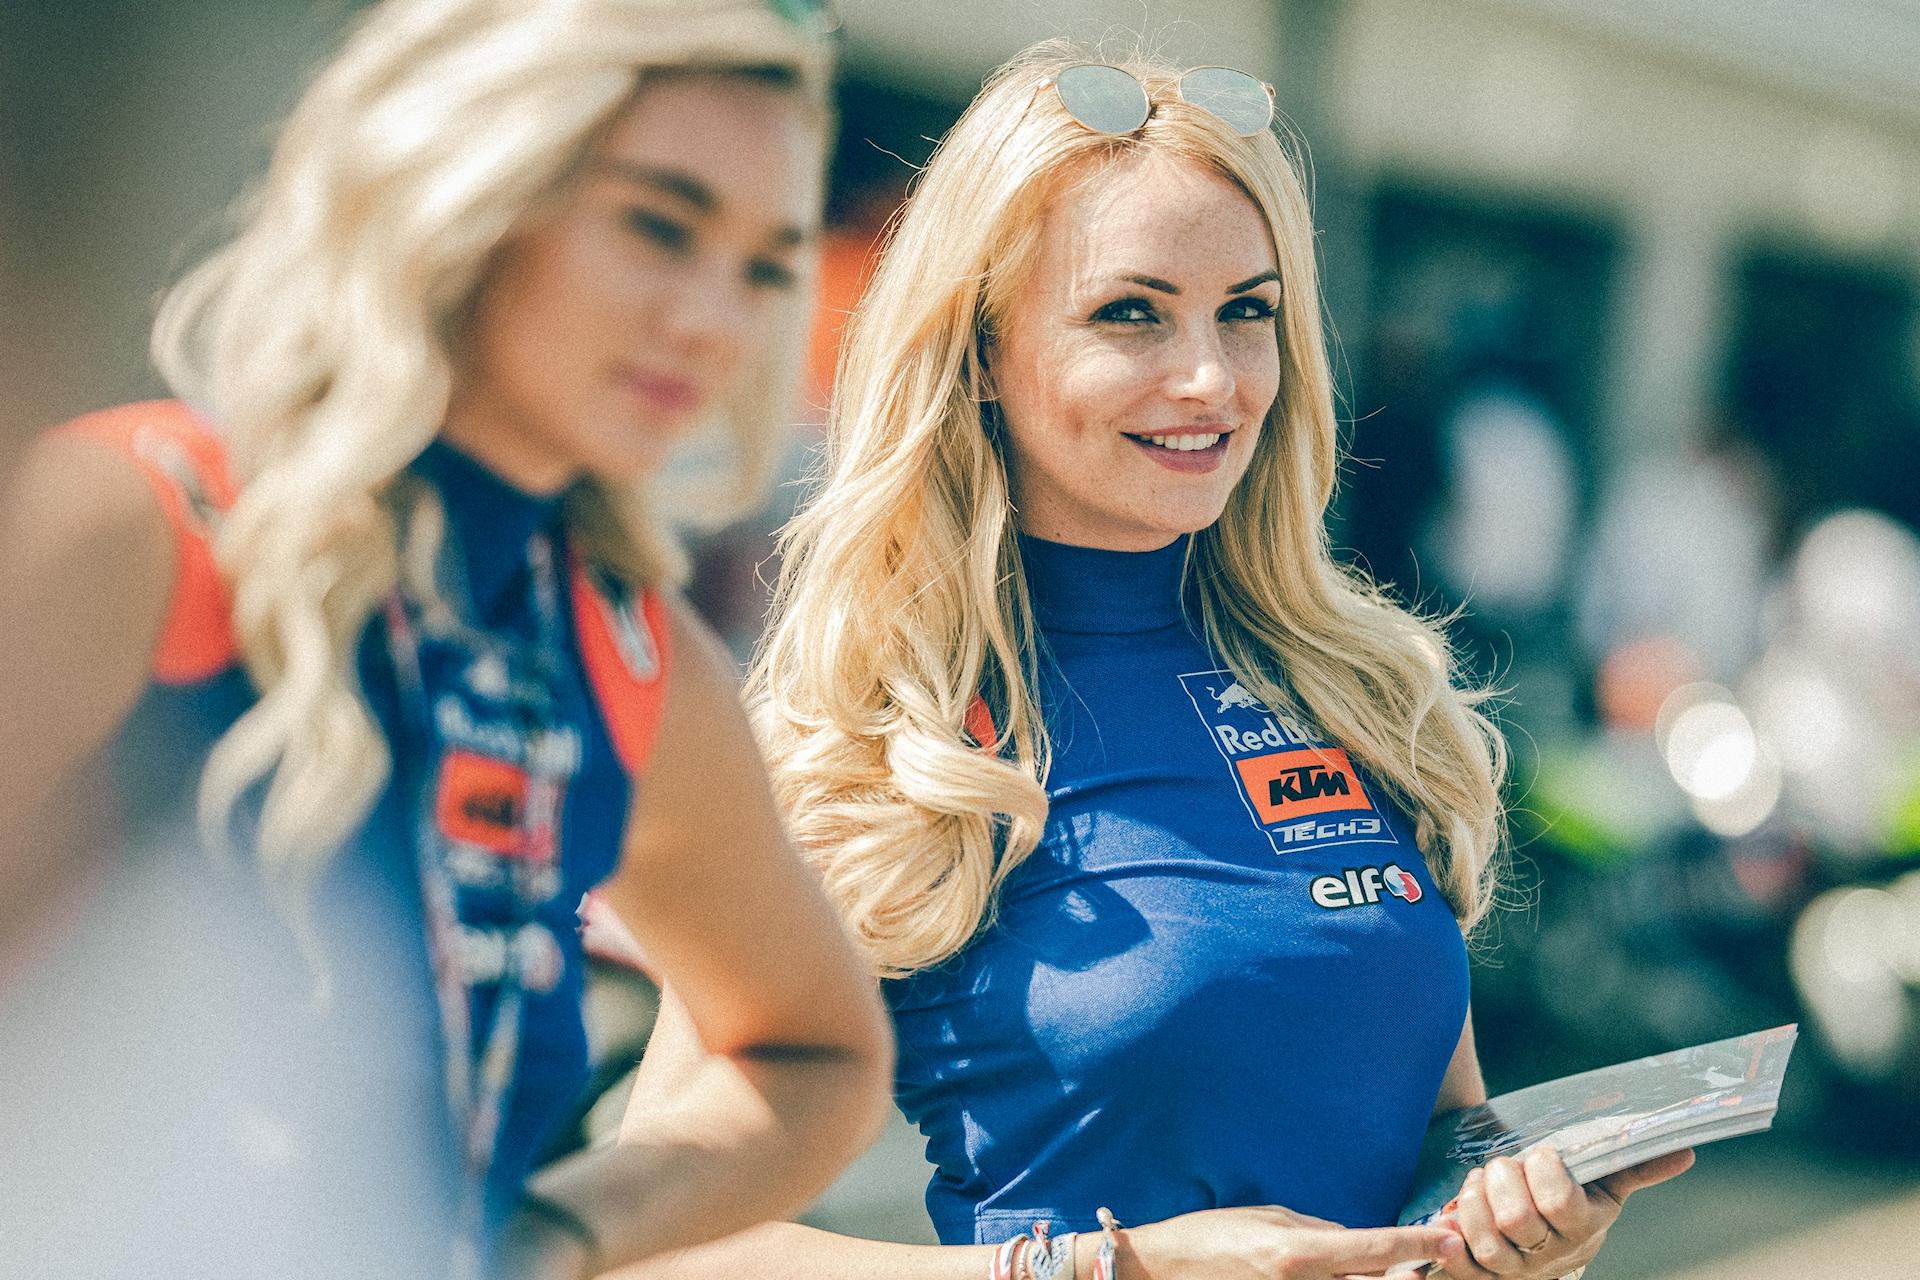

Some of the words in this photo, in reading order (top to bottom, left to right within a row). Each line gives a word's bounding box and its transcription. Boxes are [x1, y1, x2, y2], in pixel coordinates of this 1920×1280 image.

[1215, 717, 1287, 755] Red
[1268, 765, 1350, 806] KTM
[1312, 867, 1384, 908] elf
